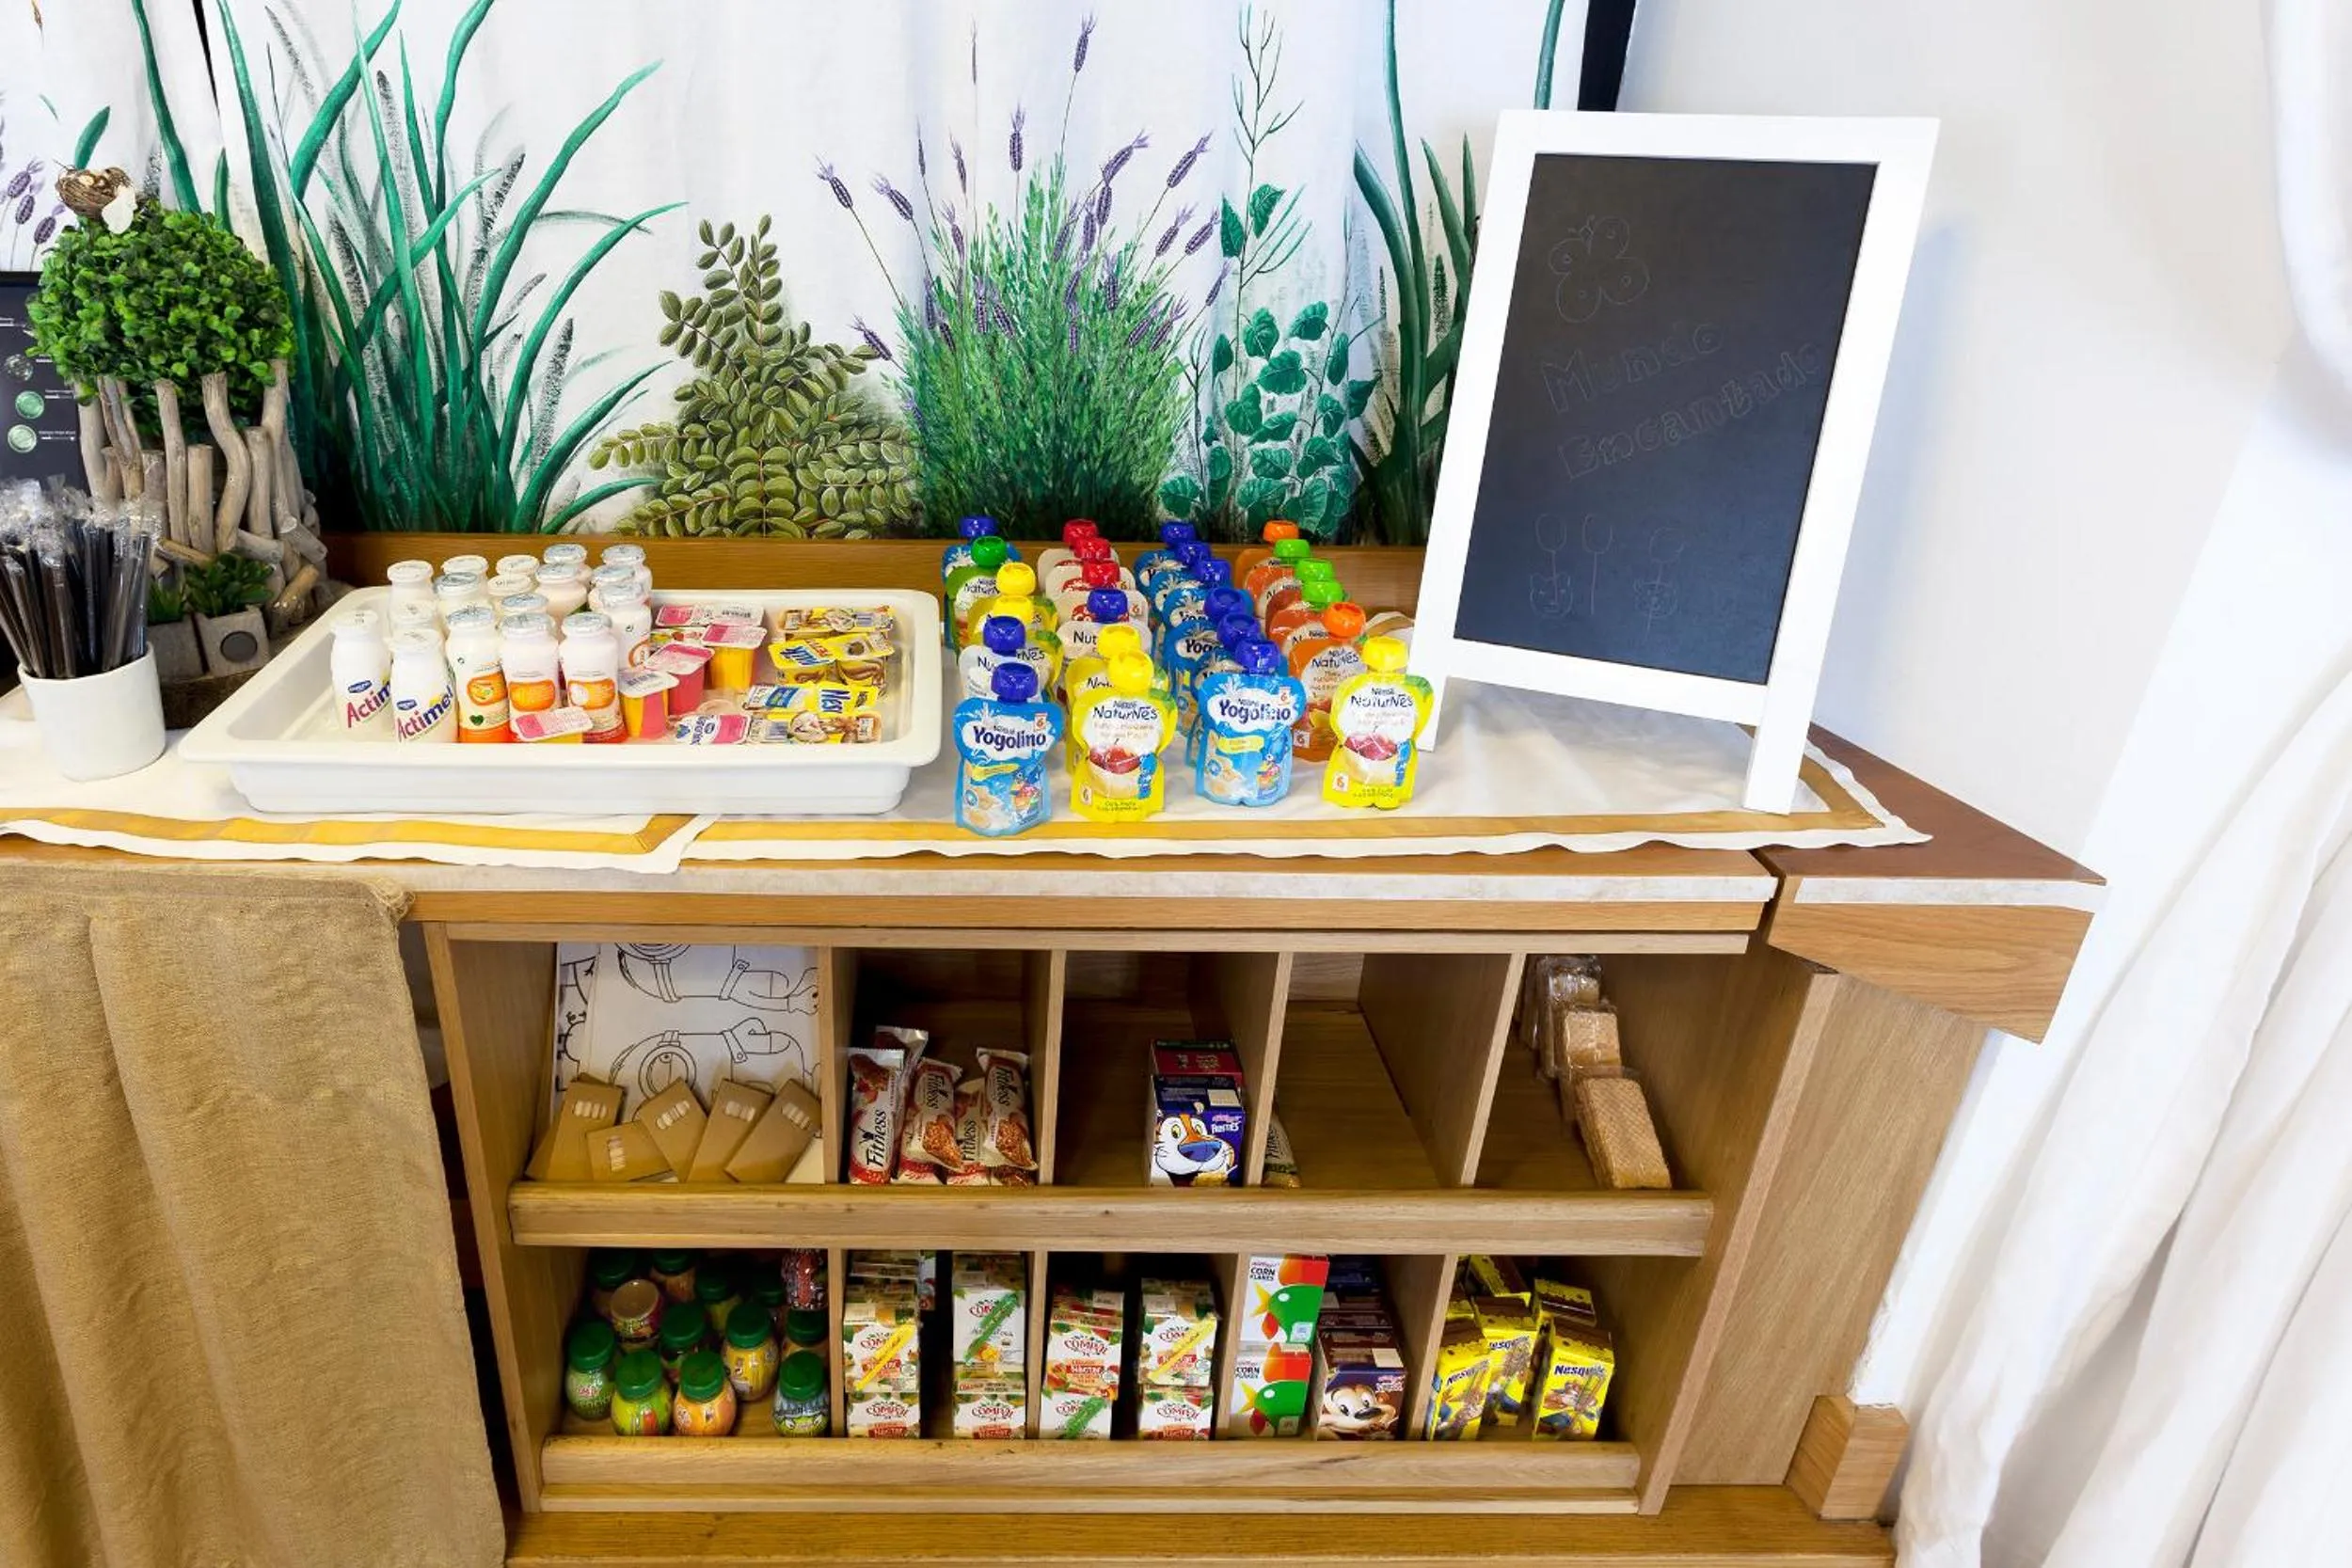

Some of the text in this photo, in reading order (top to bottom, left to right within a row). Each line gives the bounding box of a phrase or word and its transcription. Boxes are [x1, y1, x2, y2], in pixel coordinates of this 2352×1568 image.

[1558, 342, 1821, 482] Encantado
[396, 684, 453, 743] Actimel
[1219, 699, 1292, 724] Yogolino
[973, 726, 1046, 752] Yogolino
[995, 1067, 1013, 1107] Fitness
[866, 1109, 887, 1167] Fitness
[1250, 1267, 1276, 1275] CORN
[1554, 1364, 1605, 1378] Nesquik
